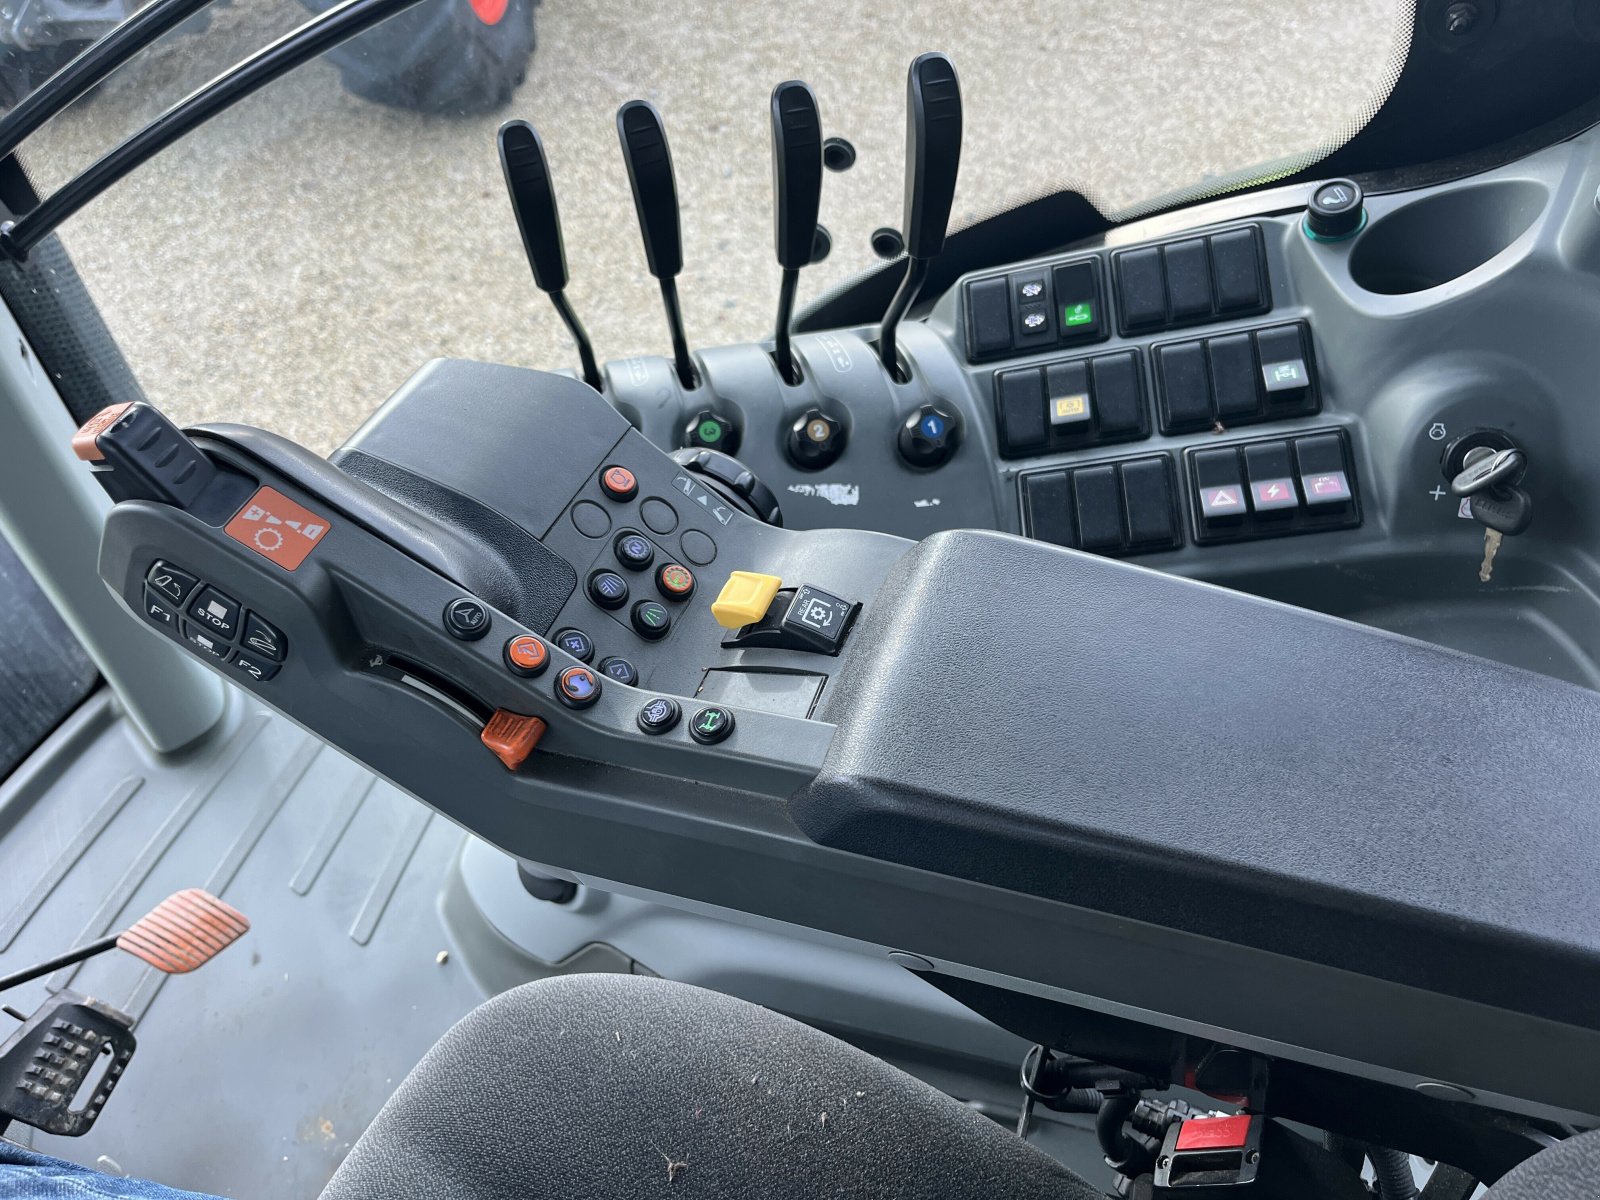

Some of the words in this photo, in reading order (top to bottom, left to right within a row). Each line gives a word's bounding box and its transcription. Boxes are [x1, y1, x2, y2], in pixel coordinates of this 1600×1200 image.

[812, 424, 824, 438] 2
[927, 419, 937, 434] 1
[150, 604, 171, 622] F1
[797, 599, 810, 616] REAR
[197, 607, 230, 629] STOP
[238, 659, 262, 679] F2
